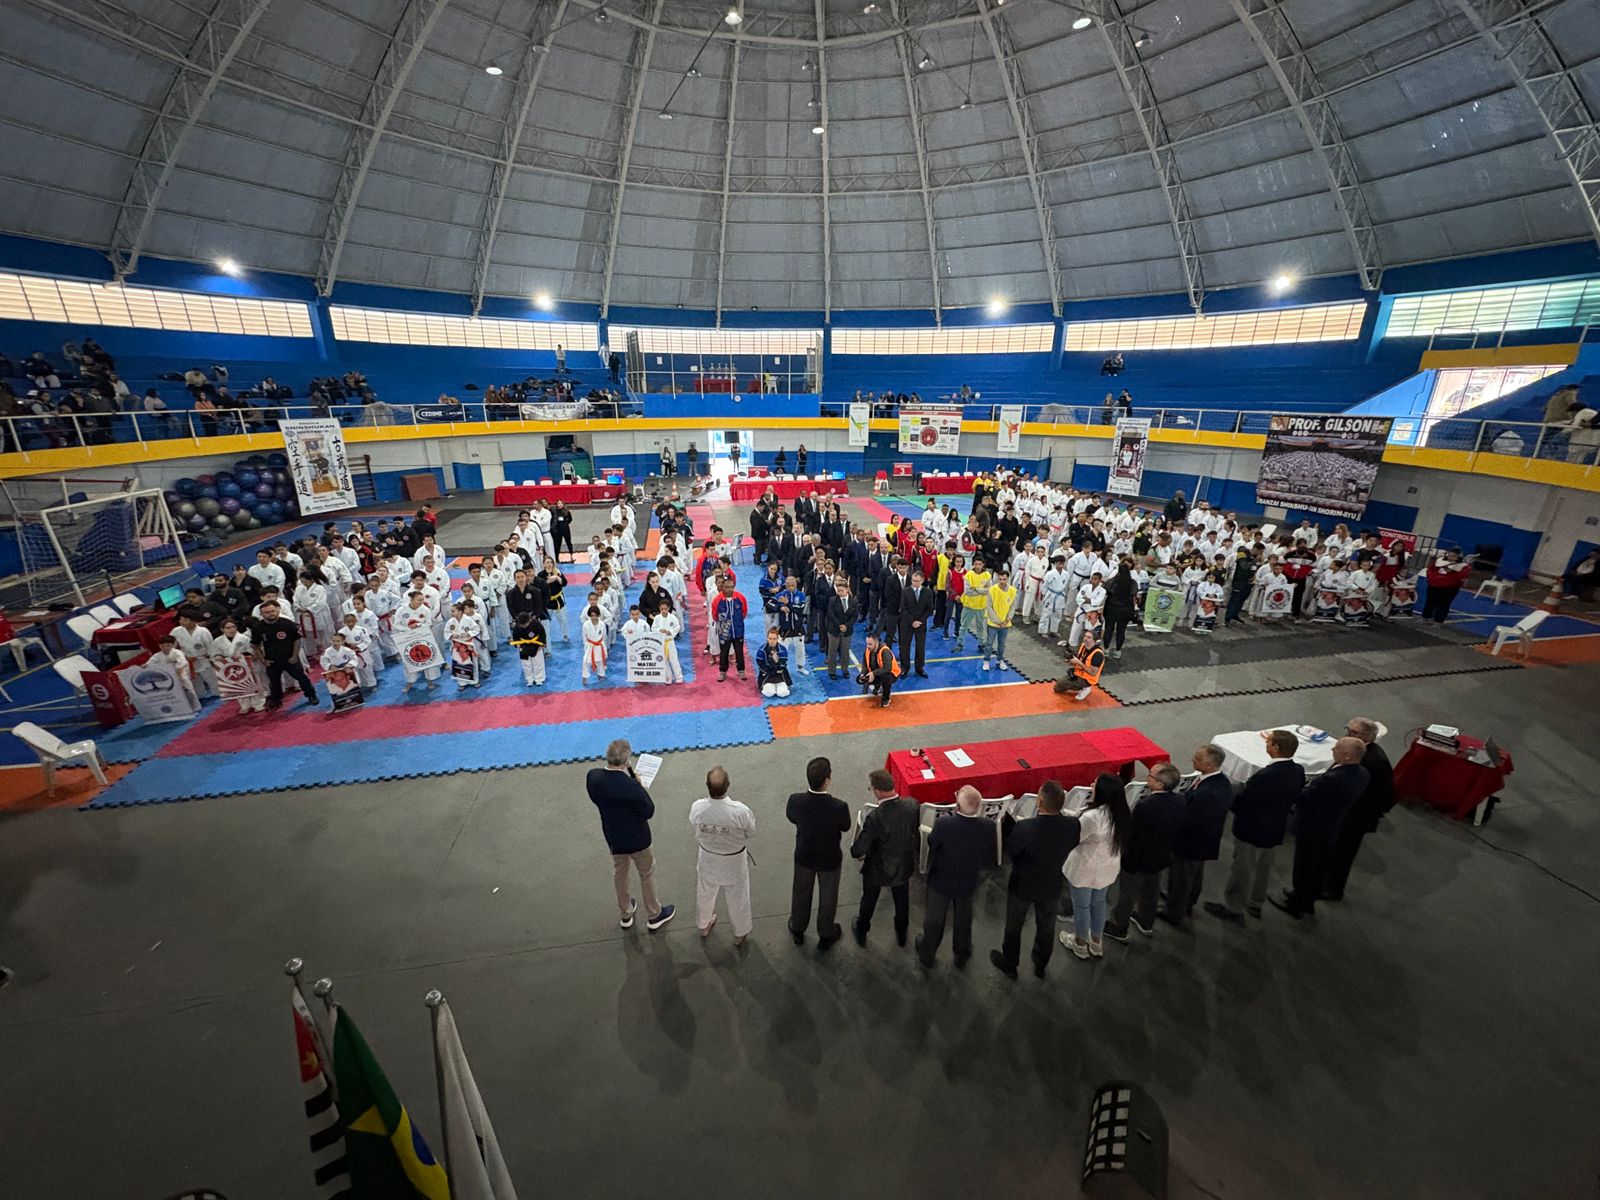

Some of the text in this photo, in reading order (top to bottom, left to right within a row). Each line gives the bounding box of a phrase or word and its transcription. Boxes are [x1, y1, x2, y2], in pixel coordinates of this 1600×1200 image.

[1288, 417, 1373, 433] PROF. GILSON
[899, 467, 906, 475] 3
[1380, 530, 1416, 543] CONTROLE
